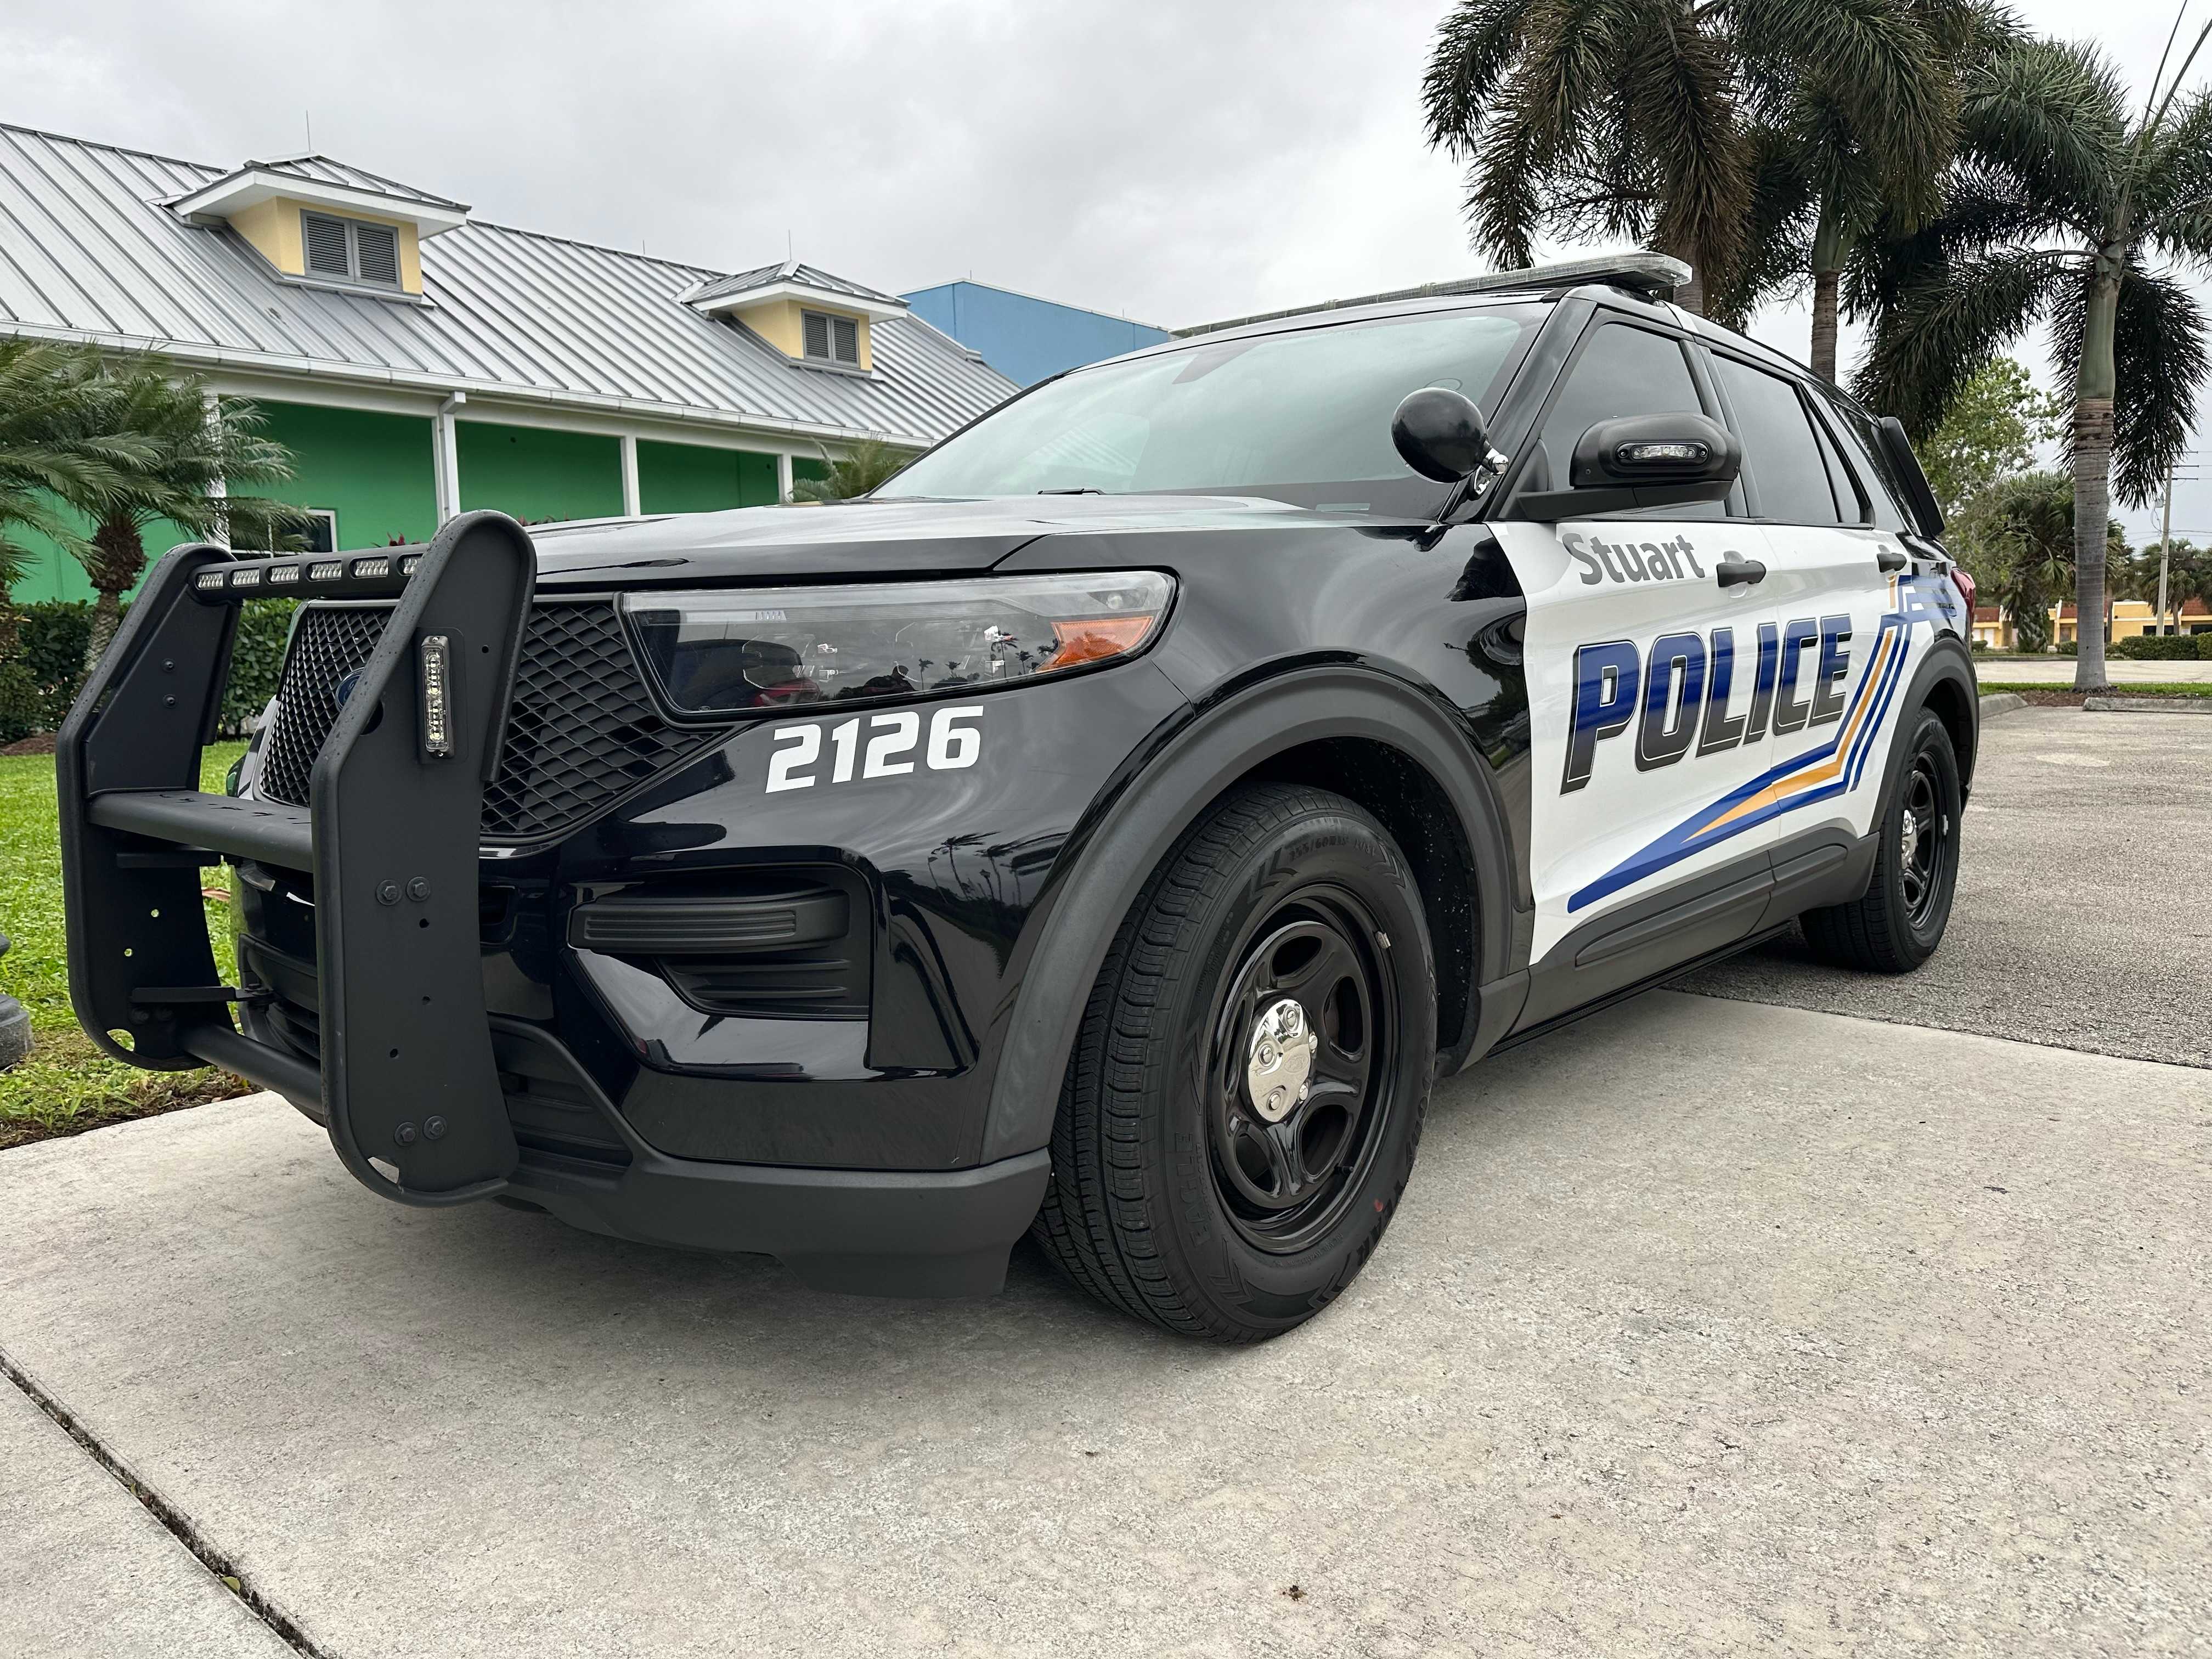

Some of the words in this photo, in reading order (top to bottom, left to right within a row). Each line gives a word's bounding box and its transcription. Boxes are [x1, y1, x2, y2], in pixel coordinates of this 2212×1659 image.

[1562, 533, 1706, 585] Stuart
[765, 705, 984, 794] 2126
[1560, 613, 1852, 797] POLICE
